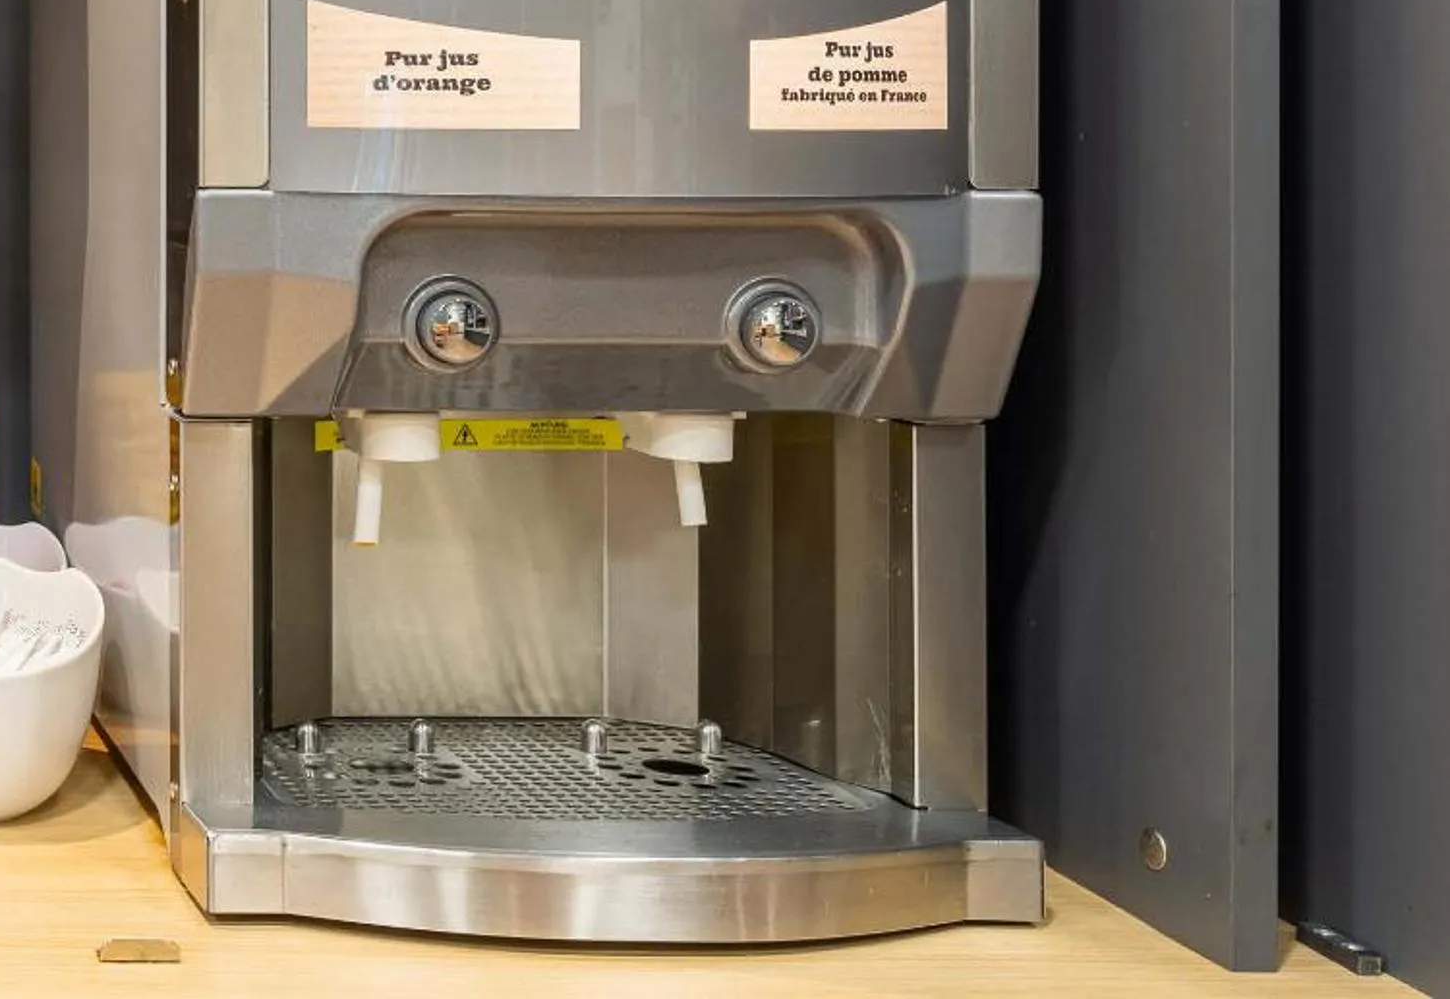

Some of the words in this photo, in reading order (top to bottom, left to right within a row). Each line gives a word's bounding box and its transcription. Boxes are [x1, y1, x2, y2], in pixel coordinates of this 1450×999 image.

[384, 51, 433, 67] Pur
[436, 48, 479, 71] jus
[825, 41, 862, 58] Pur
[864, 41, 894, 62] jus
[372, 74, 492, 96] d'orange
[808, 66, 834, 82] de
[838, 69, 908, 87] pomme
[781, 87, 856, 105] fabriqué
[858, 92, 878, 103] en
[880, 89, 928, 103] France
